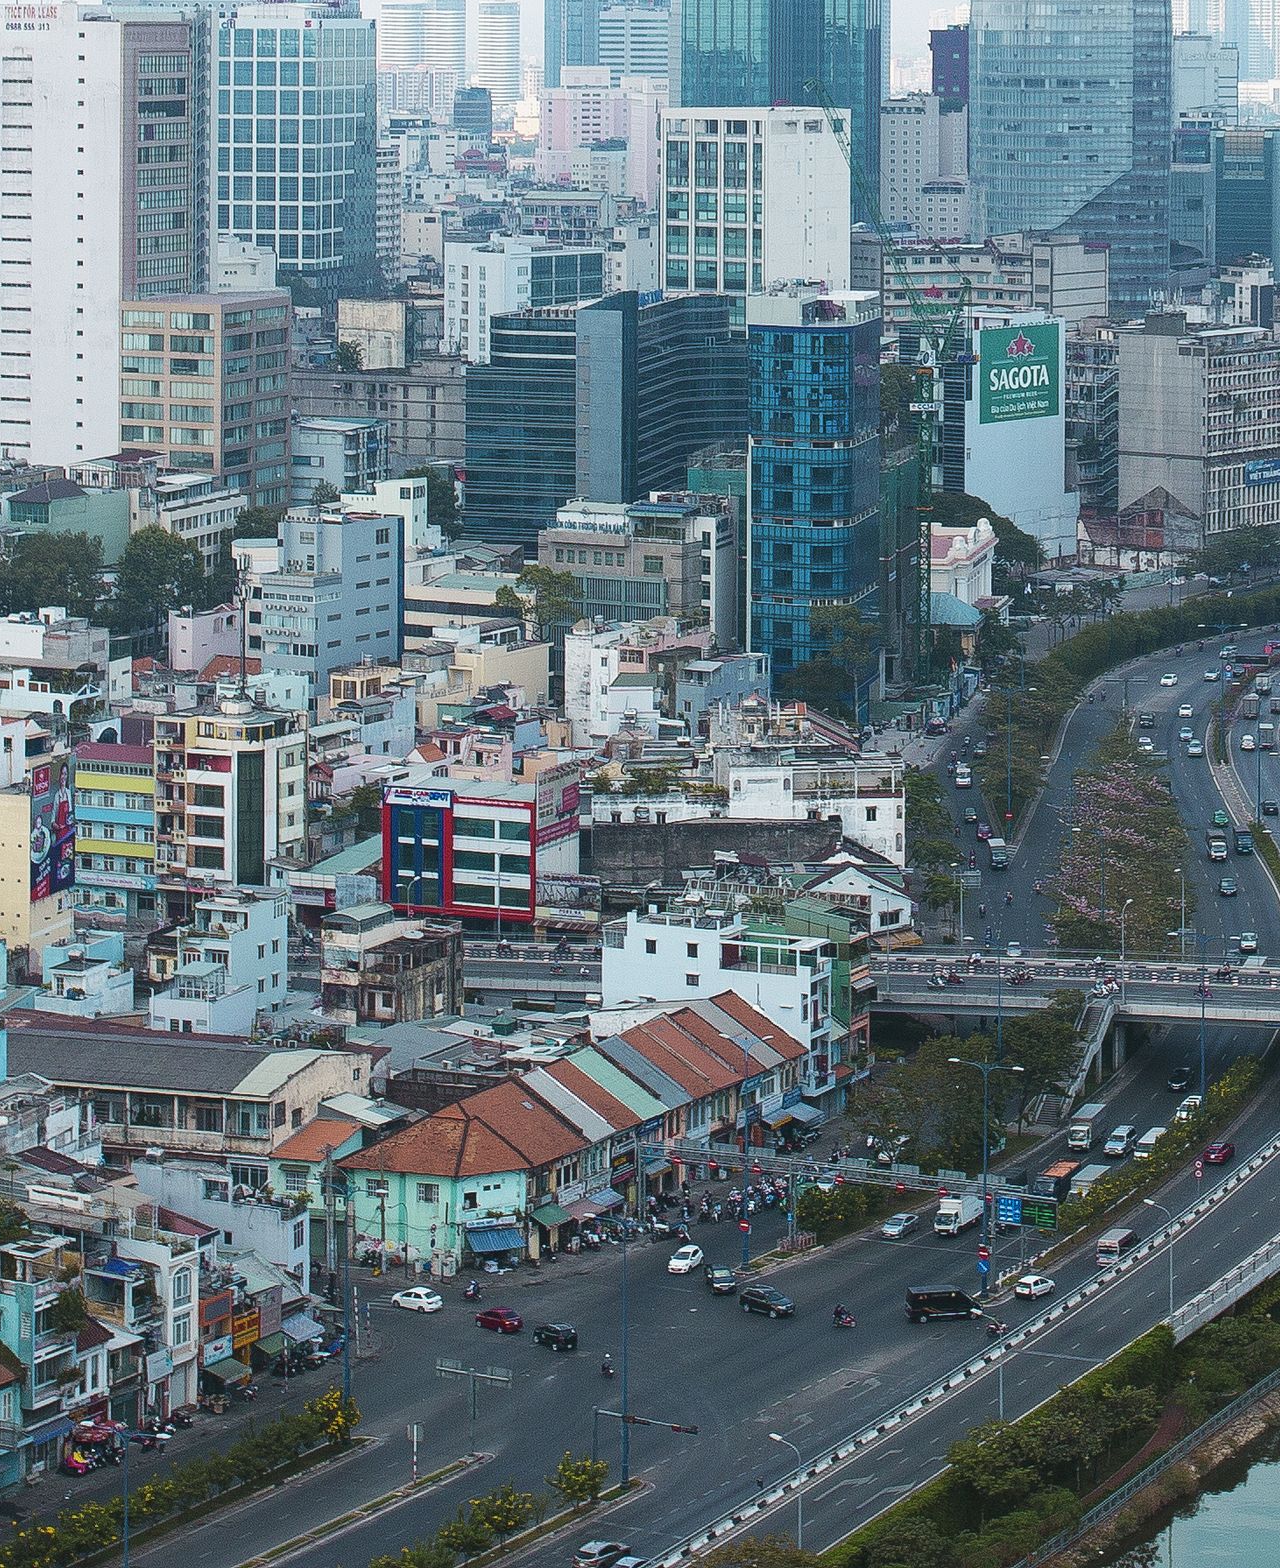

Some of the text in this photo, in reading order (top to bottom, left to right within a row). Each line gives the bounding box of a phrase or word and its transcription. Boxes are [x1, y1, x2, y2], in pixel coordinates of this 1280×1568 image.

[37, 6, 58, 19] LEASE
[221, 18, 236, 30] citi
[989, 364, 1050, 391] SAGOTA
[1037, 400, 1049, 408] Nam
[429, 791, 449, 802] DEPOT
